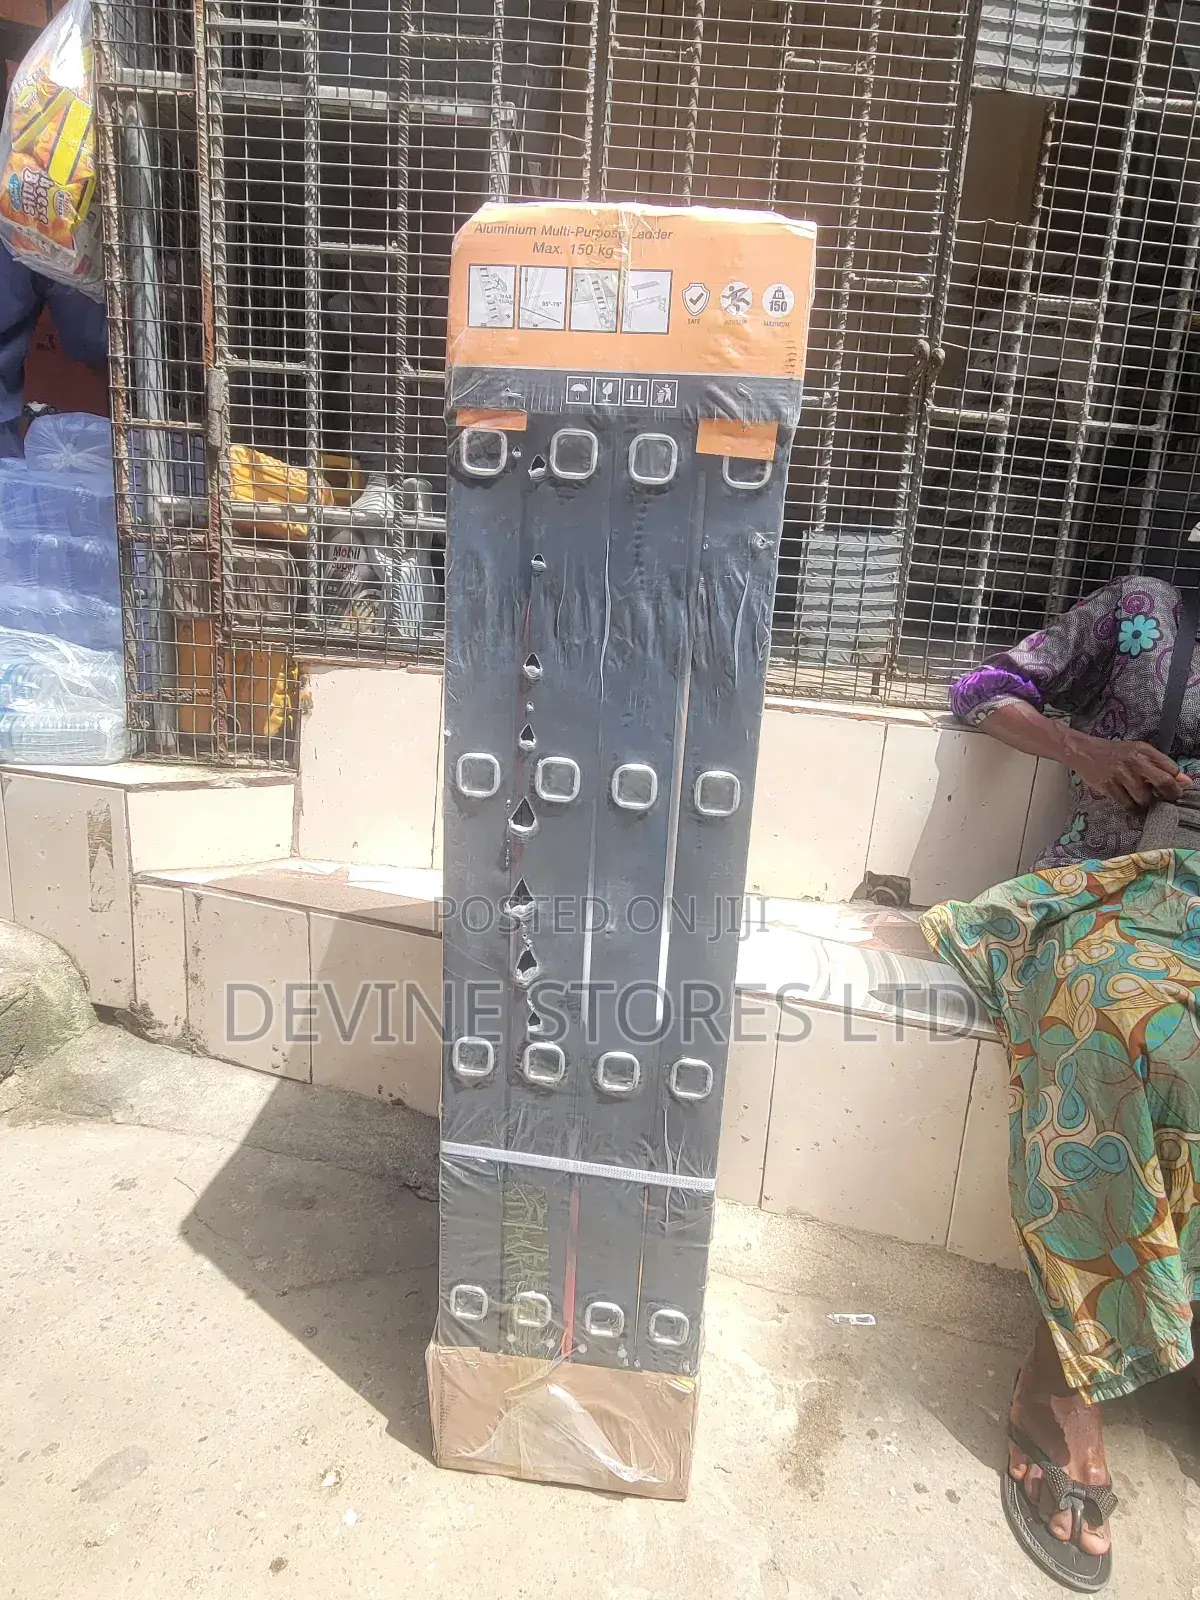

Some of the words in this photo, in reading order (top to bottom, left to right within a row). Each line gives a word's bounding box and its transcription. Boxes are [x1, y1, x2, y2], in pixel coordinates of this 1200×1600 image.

[21, 167, 40, 216] Balls
[474, 222, 537, 236] Aluminium
[532, 241, 564, 255] Max.
[569, 243, 594, 256] 150
[597, 243, 614, 259] kg
[768, 300, 788, 312] 150
[332, 545, 361, 560] Mobil
[332, 557, 357, 573] Super
